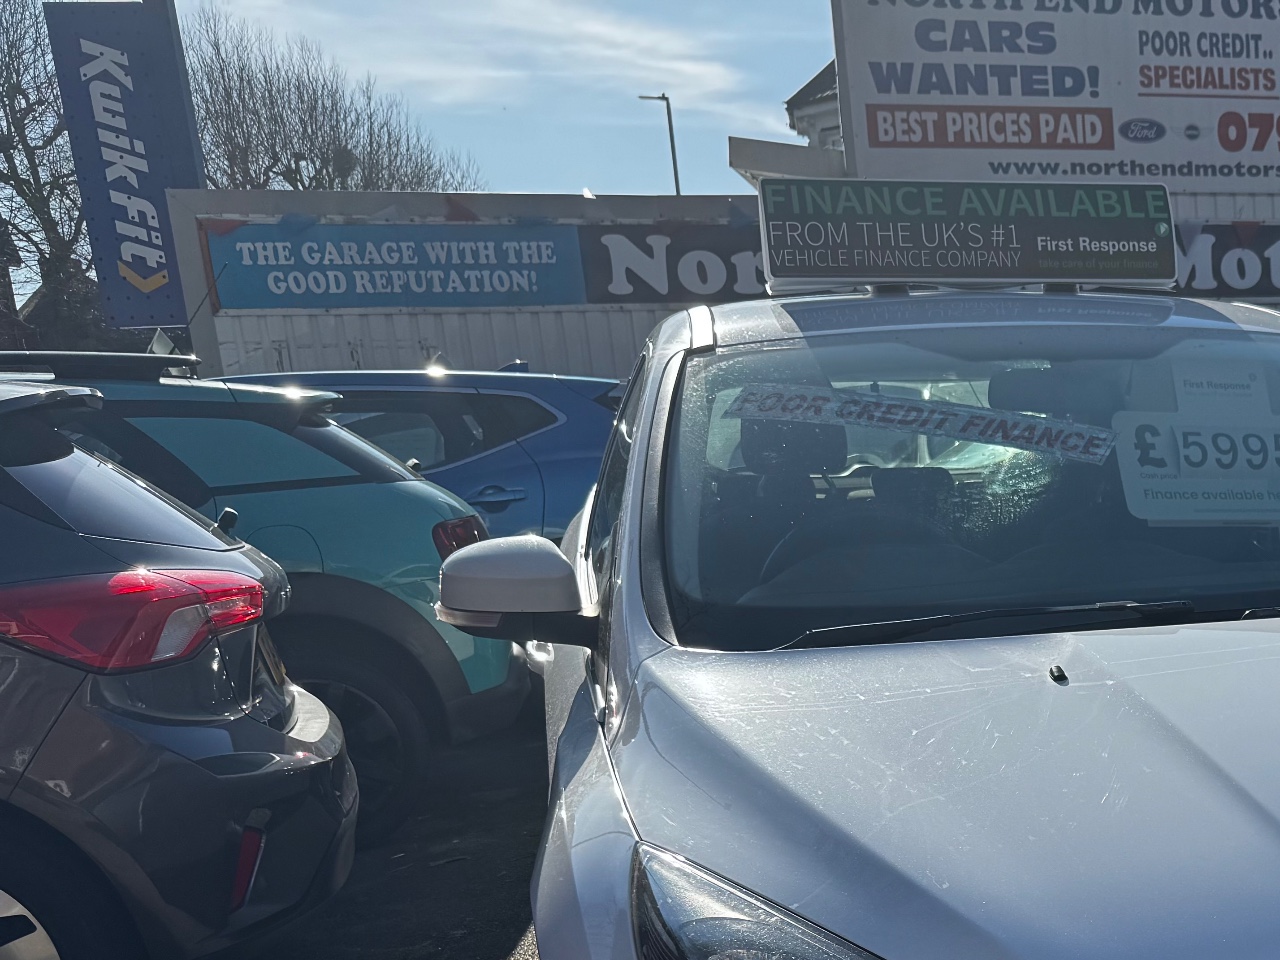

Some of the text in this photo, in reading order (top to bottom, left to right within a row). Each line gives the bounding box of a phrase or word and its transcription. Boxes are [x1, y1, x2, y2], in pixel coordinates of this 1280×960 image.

[914, 18, 1057, 55] CARS
[1138, 30, 1192, 57] POOR
[868, 61, 1100, 99] WANTED!
[1138, 64, 1276, 91] SPECIALISTS
[79, 38, 149, 189] Kwik
[876, 110, 1103, 145] BEST PRICES PAID
[767, 184, 1169, 219] FINANCE AVAILABLE
[769, 221, 848, 246] FROM
[856, 222, 913, 247] THE
[991, 224, 1021, 248] #1
[1037, 236, 1157, 255] First Response
[236, 241, 556, 265] THE GARAGE WITH THE
[601, 234, 766, 295] Nor
[771, 249, 1021, 268] VEHICLE FINANCE COMPANY
[267, 270, 538, 294] GOOD REPUTATION!
[1183, 379, 1251, 391] First Response
[734, 390, 1108, 457] POOR CREDIT FINANCE
[1143, 488, 1200, 500] Finance
[1202, 488, 1264, 501] available
